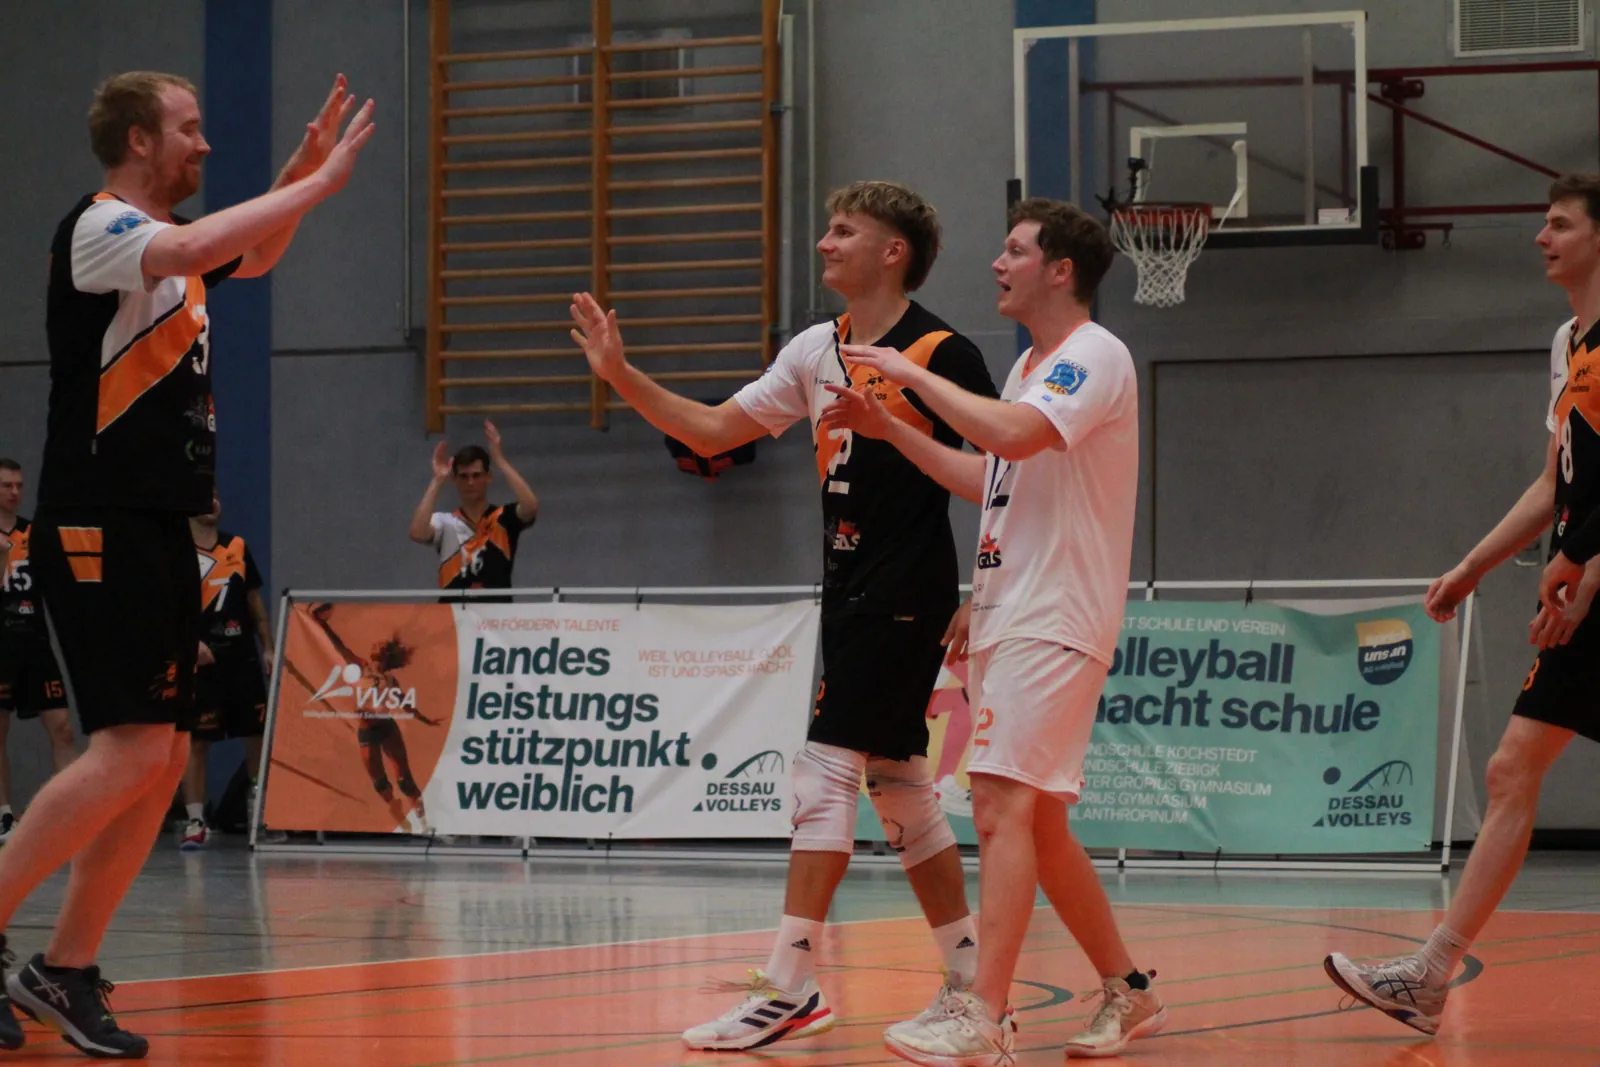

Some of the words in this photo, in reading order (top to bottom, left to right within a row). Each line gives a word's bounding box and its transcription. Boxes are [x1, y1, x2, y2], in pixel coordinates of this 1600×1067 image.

[4, 559, 32, 592] 15
[208, 577, 231, 612] 7
[477, 619, 498, 631] WIR
[500, 616, 560, 631] FÖRDERN
[563, 619, 620, 632] TALENTE
[1137, 616, 1195, 632] SCHULE
[1197, 618, 1229, 633] UND
[1232, 620, 1286, 636] VEREIN
[472, 637, 611, 676] landes
[638, 649, 668, 663] WEIL
[674, 648, 757, 663] VOLLEYBALL
[648, 665, 669, 678] IST
[672, 665, 700, 678] UND
[702, 664, 745, 678] SPASS
[356, 686, 417, 709] VVSA
[466, 682, 660, 731] leistungs
[1220, 693, 1381, 734] schule
[460, 728, 691, 773] stützpunkt
[1167, 745, 1258, 763] KOCHSTEDT
[1165, 761, 1221, 777] ZIEBIGK
[457, 773, 635, 813] weiblich
[706, 782, 775, 796] DESSAU
[1084, 774, 1111, 789] TER
[1179, 779, 1272, 796] GYMNASIUM
[706, 798, 782, 812] VOLLEYS
[1118, 792, 1208, 809] GYMNASIUM
[1328, 794, 1404, 810] DESSAU
[1327, 811, 1412, 827] VOLLEYS
